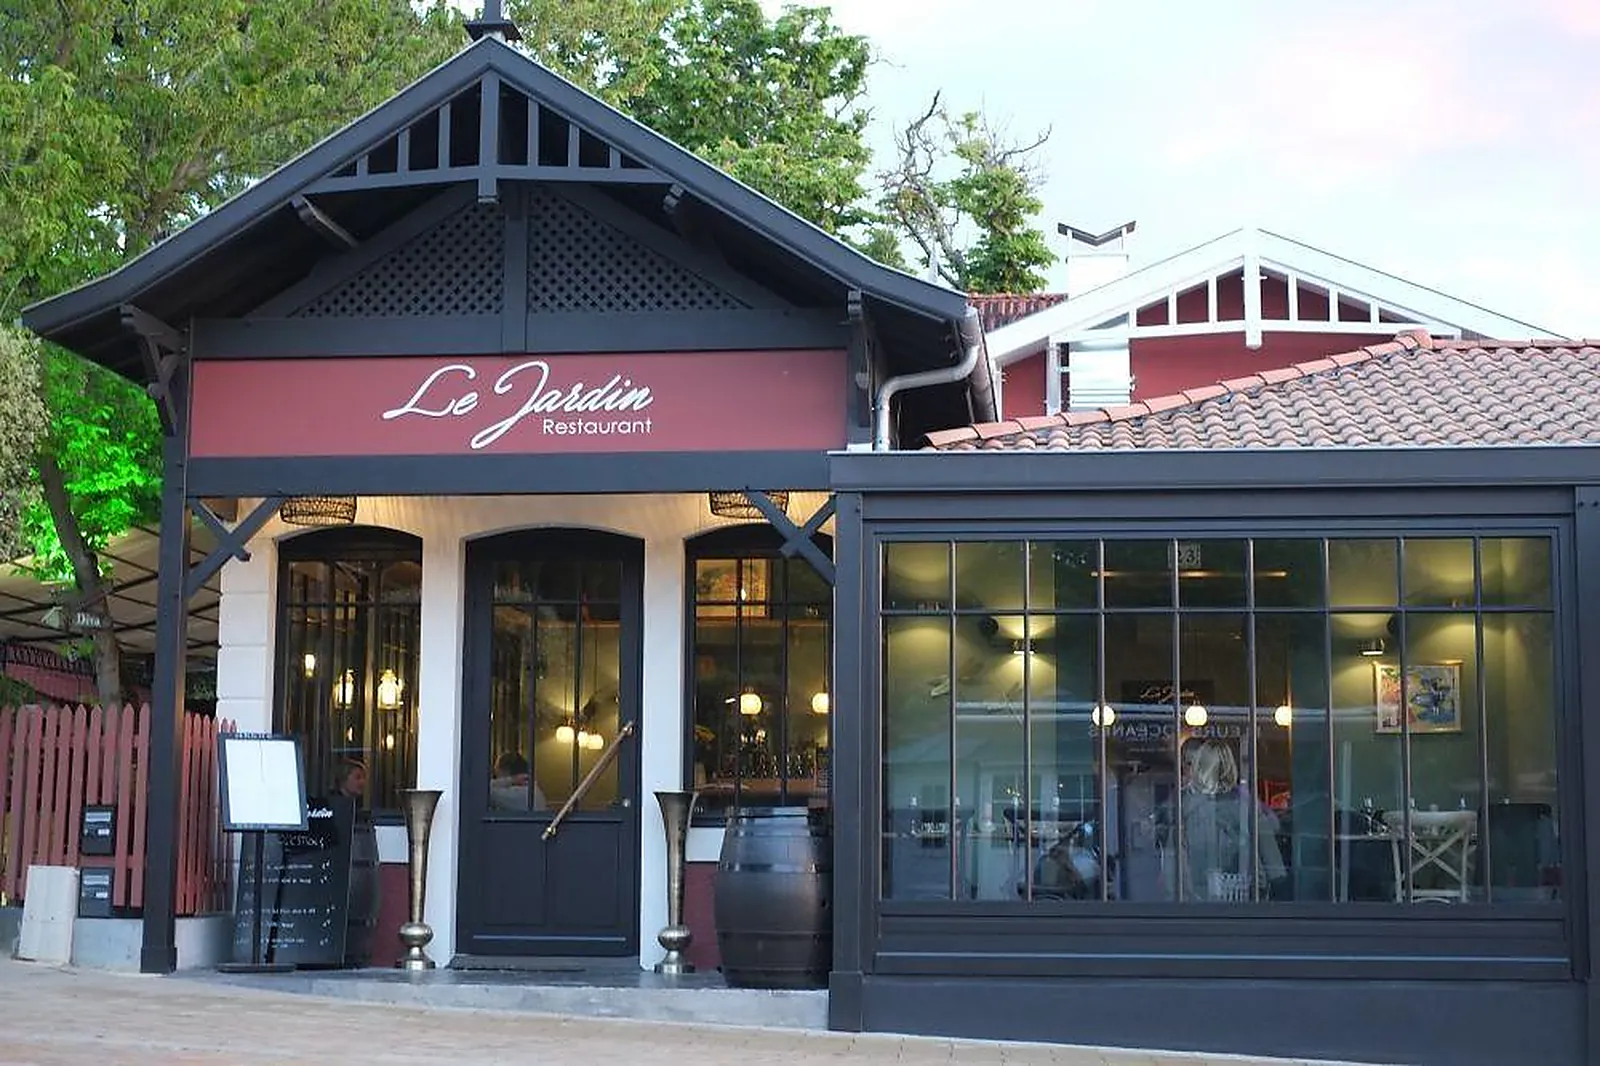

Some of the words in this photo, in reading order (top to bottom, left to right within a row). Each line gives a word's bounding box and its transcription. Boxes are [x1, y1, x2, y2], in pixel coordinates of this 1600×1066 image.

[382, 364, 478, 419] Le
[470, 360, 653, 449] Jardin
[542, 418, 652, 435] Restaurant
